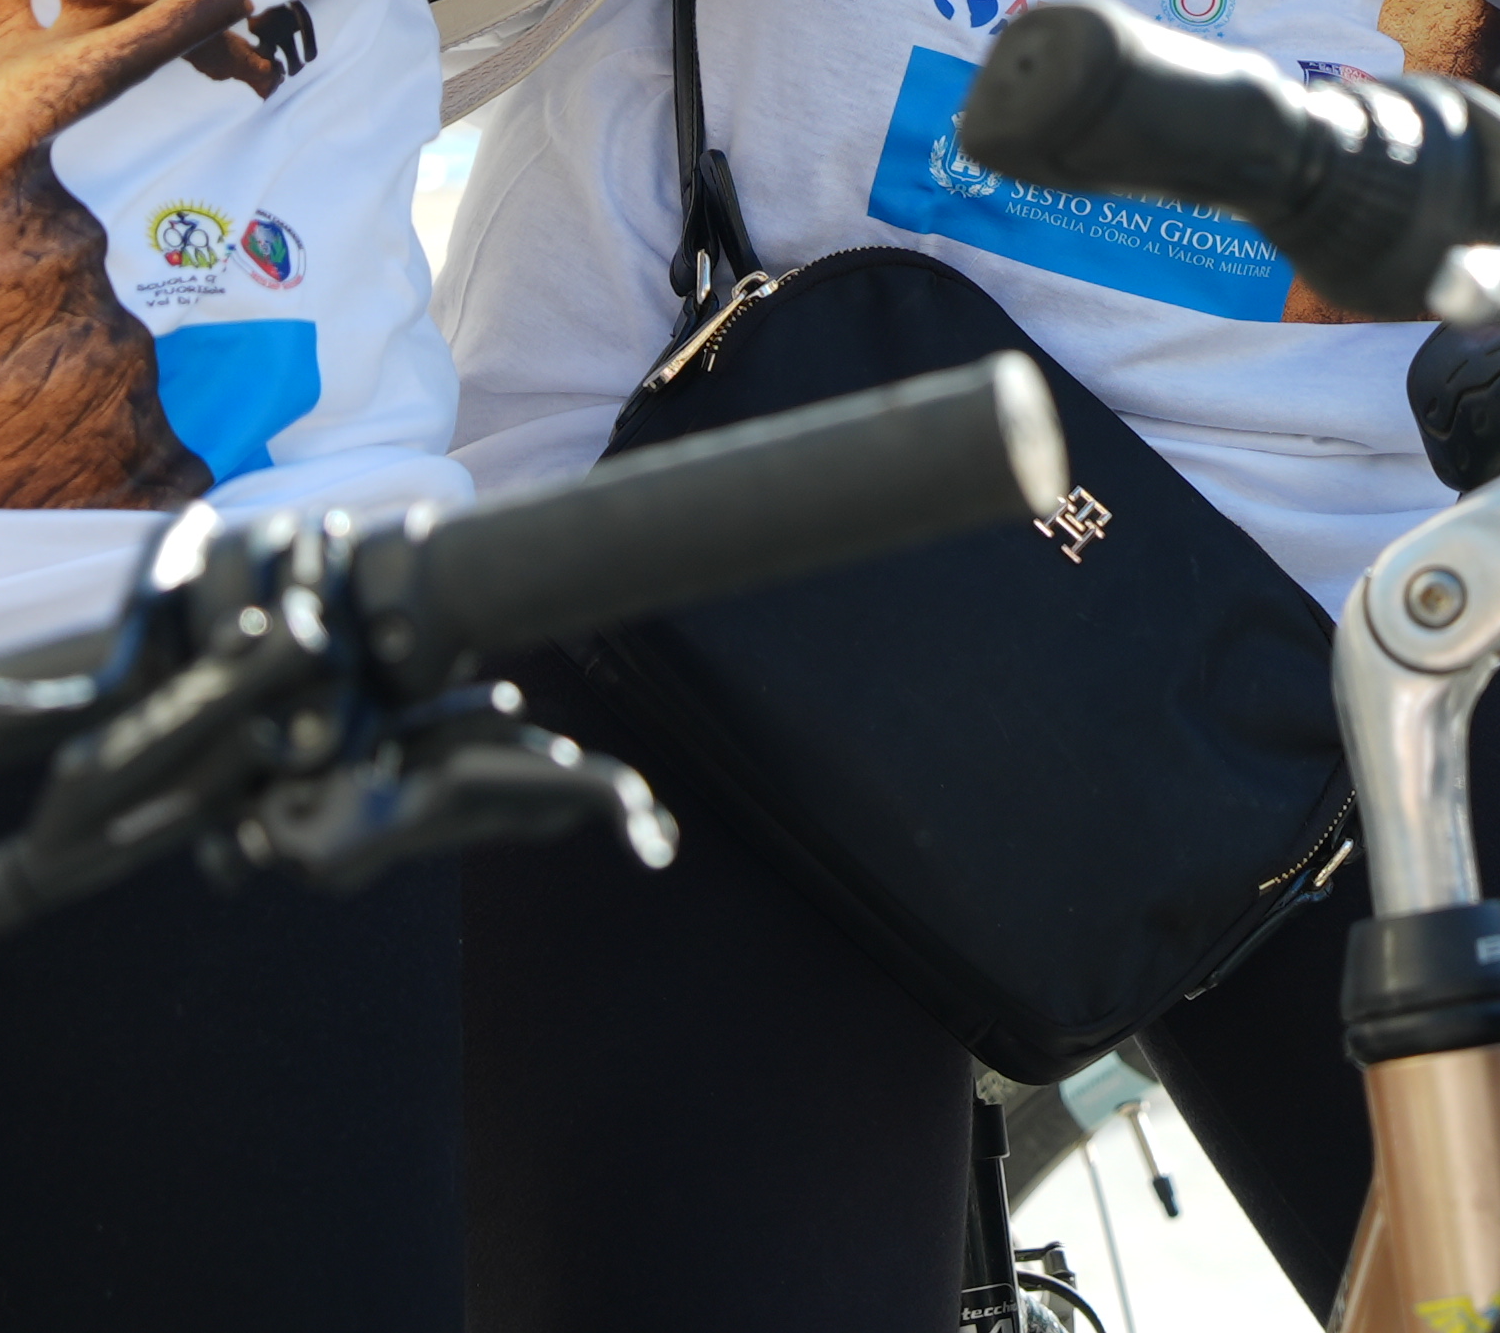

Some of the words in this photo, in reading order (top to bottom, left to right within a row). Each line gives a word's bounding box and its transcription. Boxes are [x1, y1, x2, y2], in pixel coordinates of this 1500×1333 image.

[1005, 199, 1085, 234] MEDAGLIA
[1088, 225, 1141, 251] D'ORO
[1143, 239, 1162, 255] AL
[1168, 245, 1216, 270] VALOR
[1218, 259, 1273, 279] MILITARE
[1010, 179, 1093, 216] SESTO
[1098, 201, 1154, 234] SAN
[1159, 219, 1278, 263] GIOVANNI
